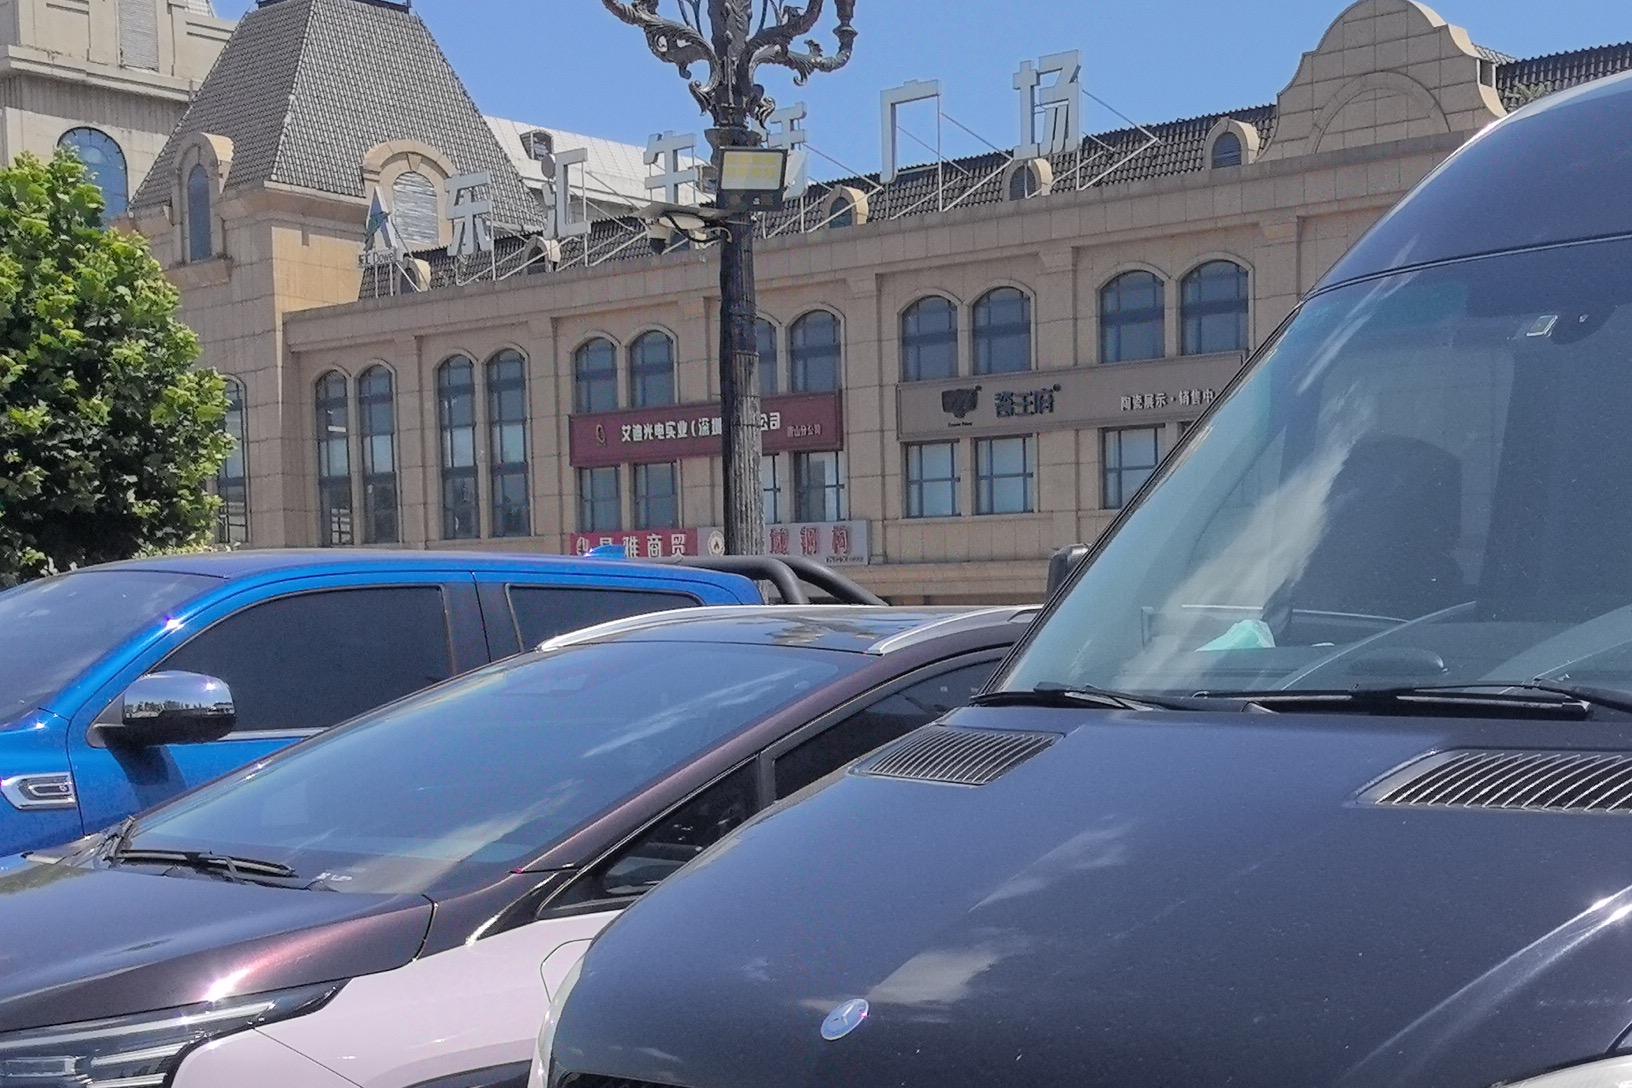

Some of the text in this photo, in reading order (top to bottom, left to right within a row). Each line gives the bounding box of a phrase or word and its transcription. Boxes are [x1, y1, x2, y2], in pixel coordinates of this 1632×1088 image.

[1119, 388, 1222, 412] 陶瓷展示·销售中
